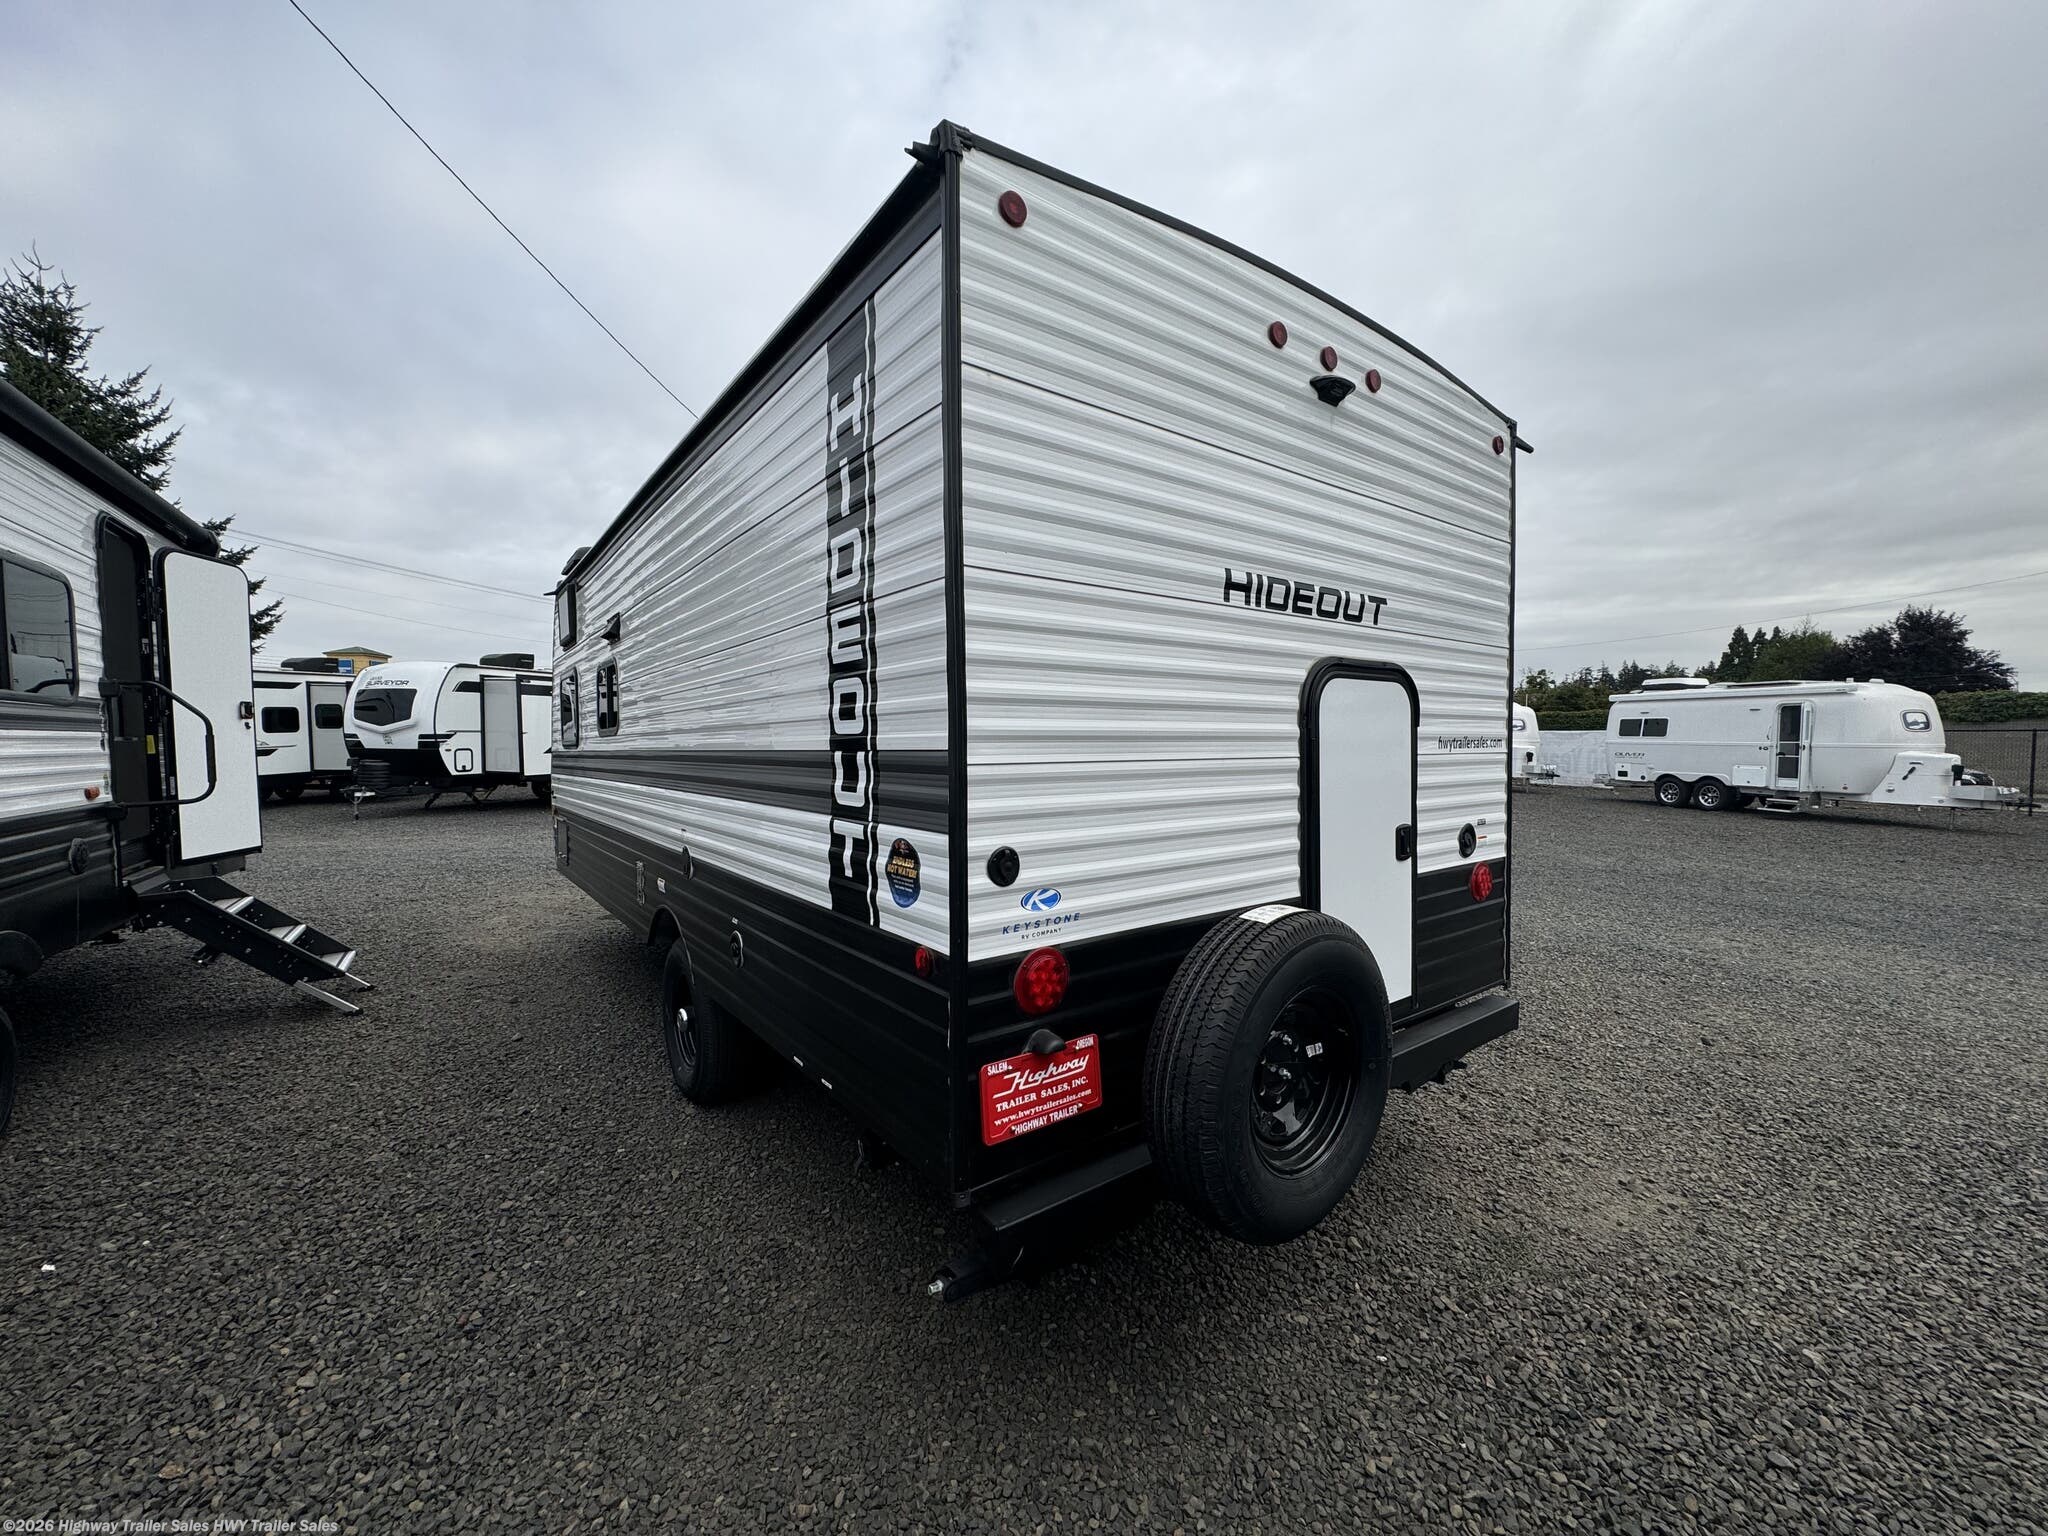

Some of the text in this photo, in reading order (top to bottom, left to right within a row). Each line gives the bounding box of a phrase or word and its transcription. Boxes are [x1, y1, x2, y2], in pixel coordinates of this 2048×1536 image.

[1223, 567, 1388, 626] HIDEOUT
[829, 372, 866, 878] HIDEOUT
[1437, 735, 1503, 753] hwytrailersales.com
[1002, 912, 1080, 935] KEYSTONE
[1031, 928, 1062, 938] COMPANY
[987, 1061, 1008, 1076] SALEM
[993, 1054, 1090, 1099] Highway
[993, 1088, 1092, 1127] www.hwytrailersales.com
[995, 1076, 1089, 1113] TRAILER SALES, INC.
